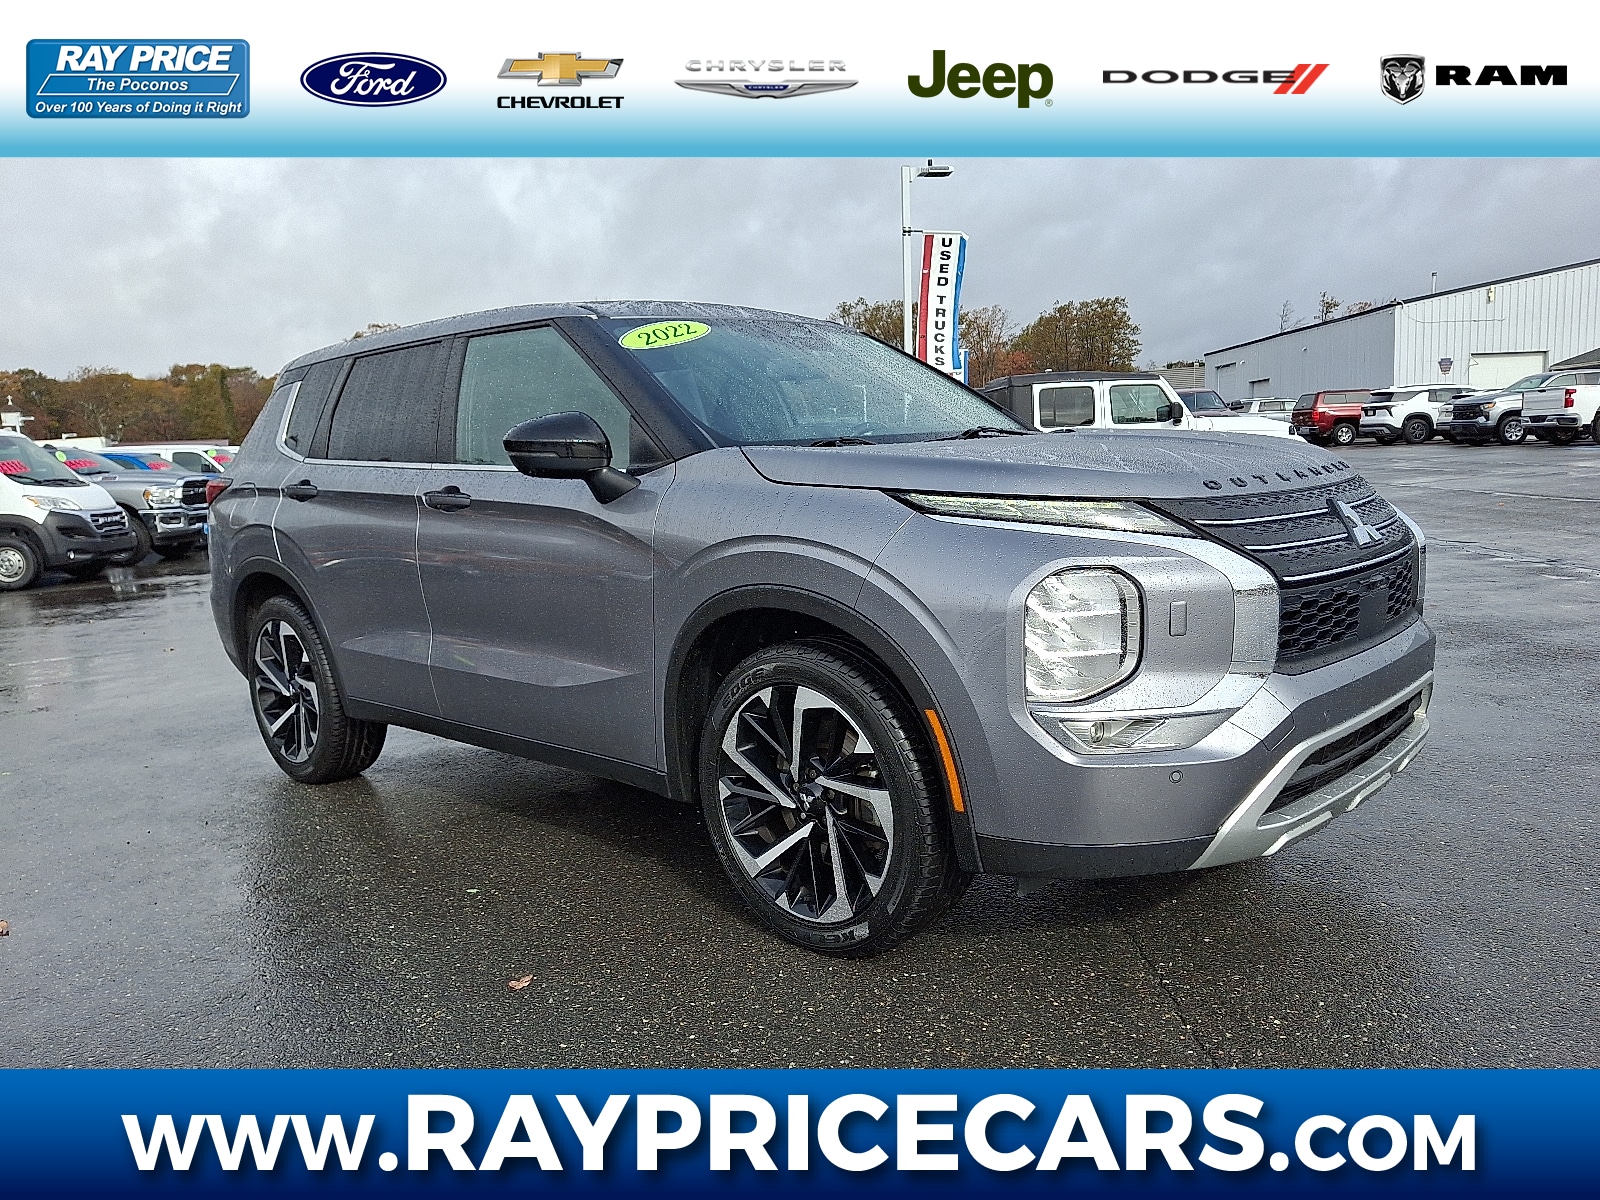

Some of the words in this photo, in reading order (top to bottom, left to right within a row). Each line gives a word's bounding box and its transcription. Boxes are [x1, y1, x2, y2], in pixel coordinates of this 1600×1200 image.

[937, 237, 953, 286] USED
[638, 324, 697, 345] 2022
[934, 295, 947, 366] TRUCKS
[1203, 460, 1350, 490] OUTLANDER
